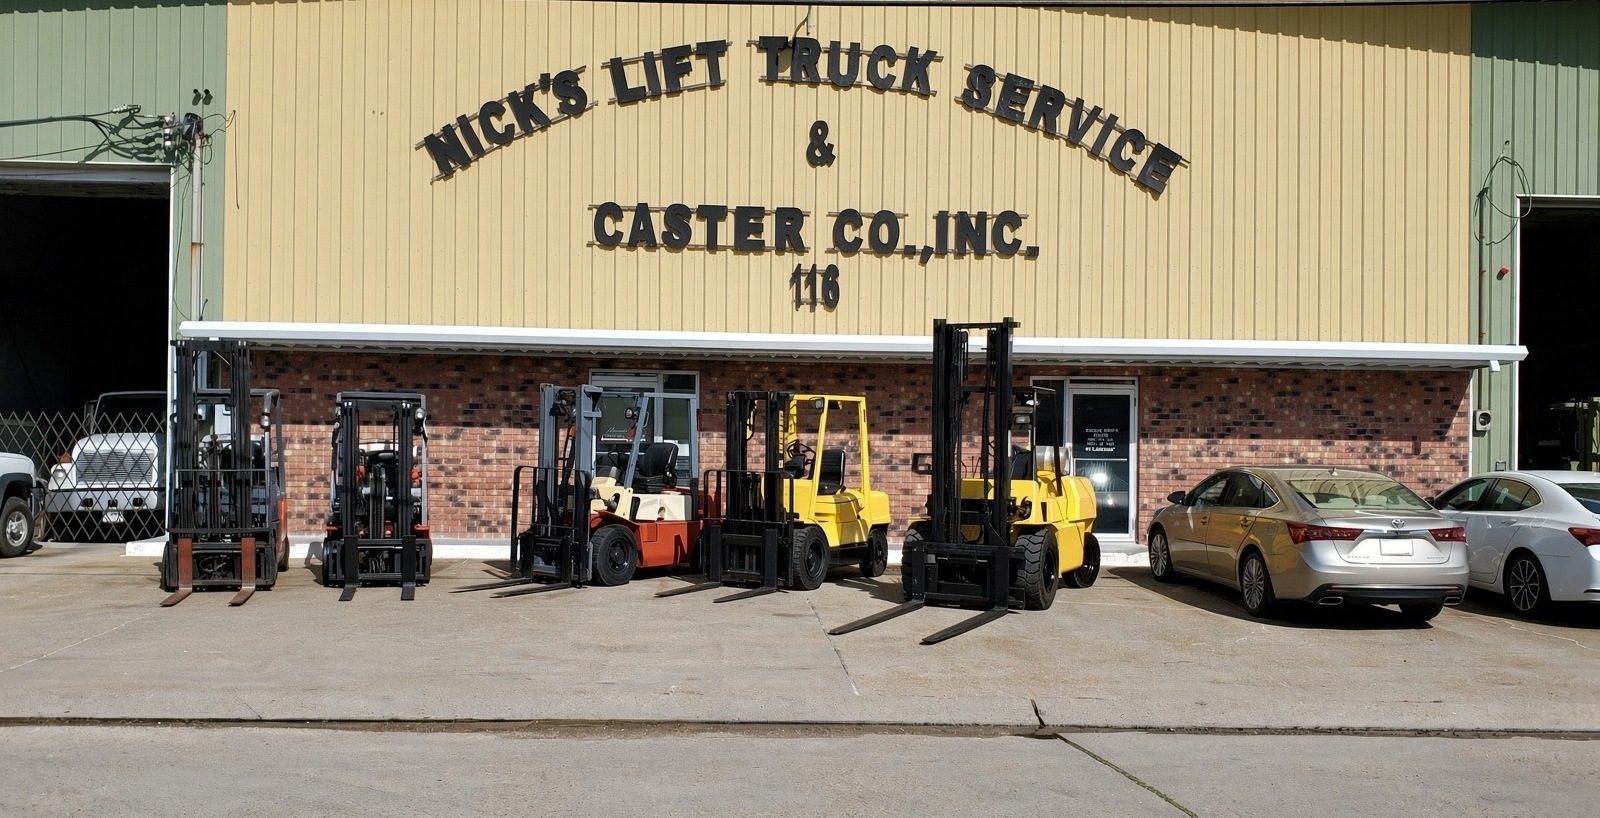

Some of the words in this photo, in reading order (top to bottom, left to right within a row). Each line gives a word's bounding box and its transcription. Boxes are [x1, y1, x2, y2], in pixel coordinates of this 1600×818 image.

[424, 69, 588, 176] NICK'S
[609, 39, 727, 104] LIFT
[758, 36, 938, 97] TRUCK
[961, 64, 1182, 194] SERVICE
[806, 120, 835, 167] &
[594, 202, 806, 252] CASTER
[790, 263, 840, 312] 116
